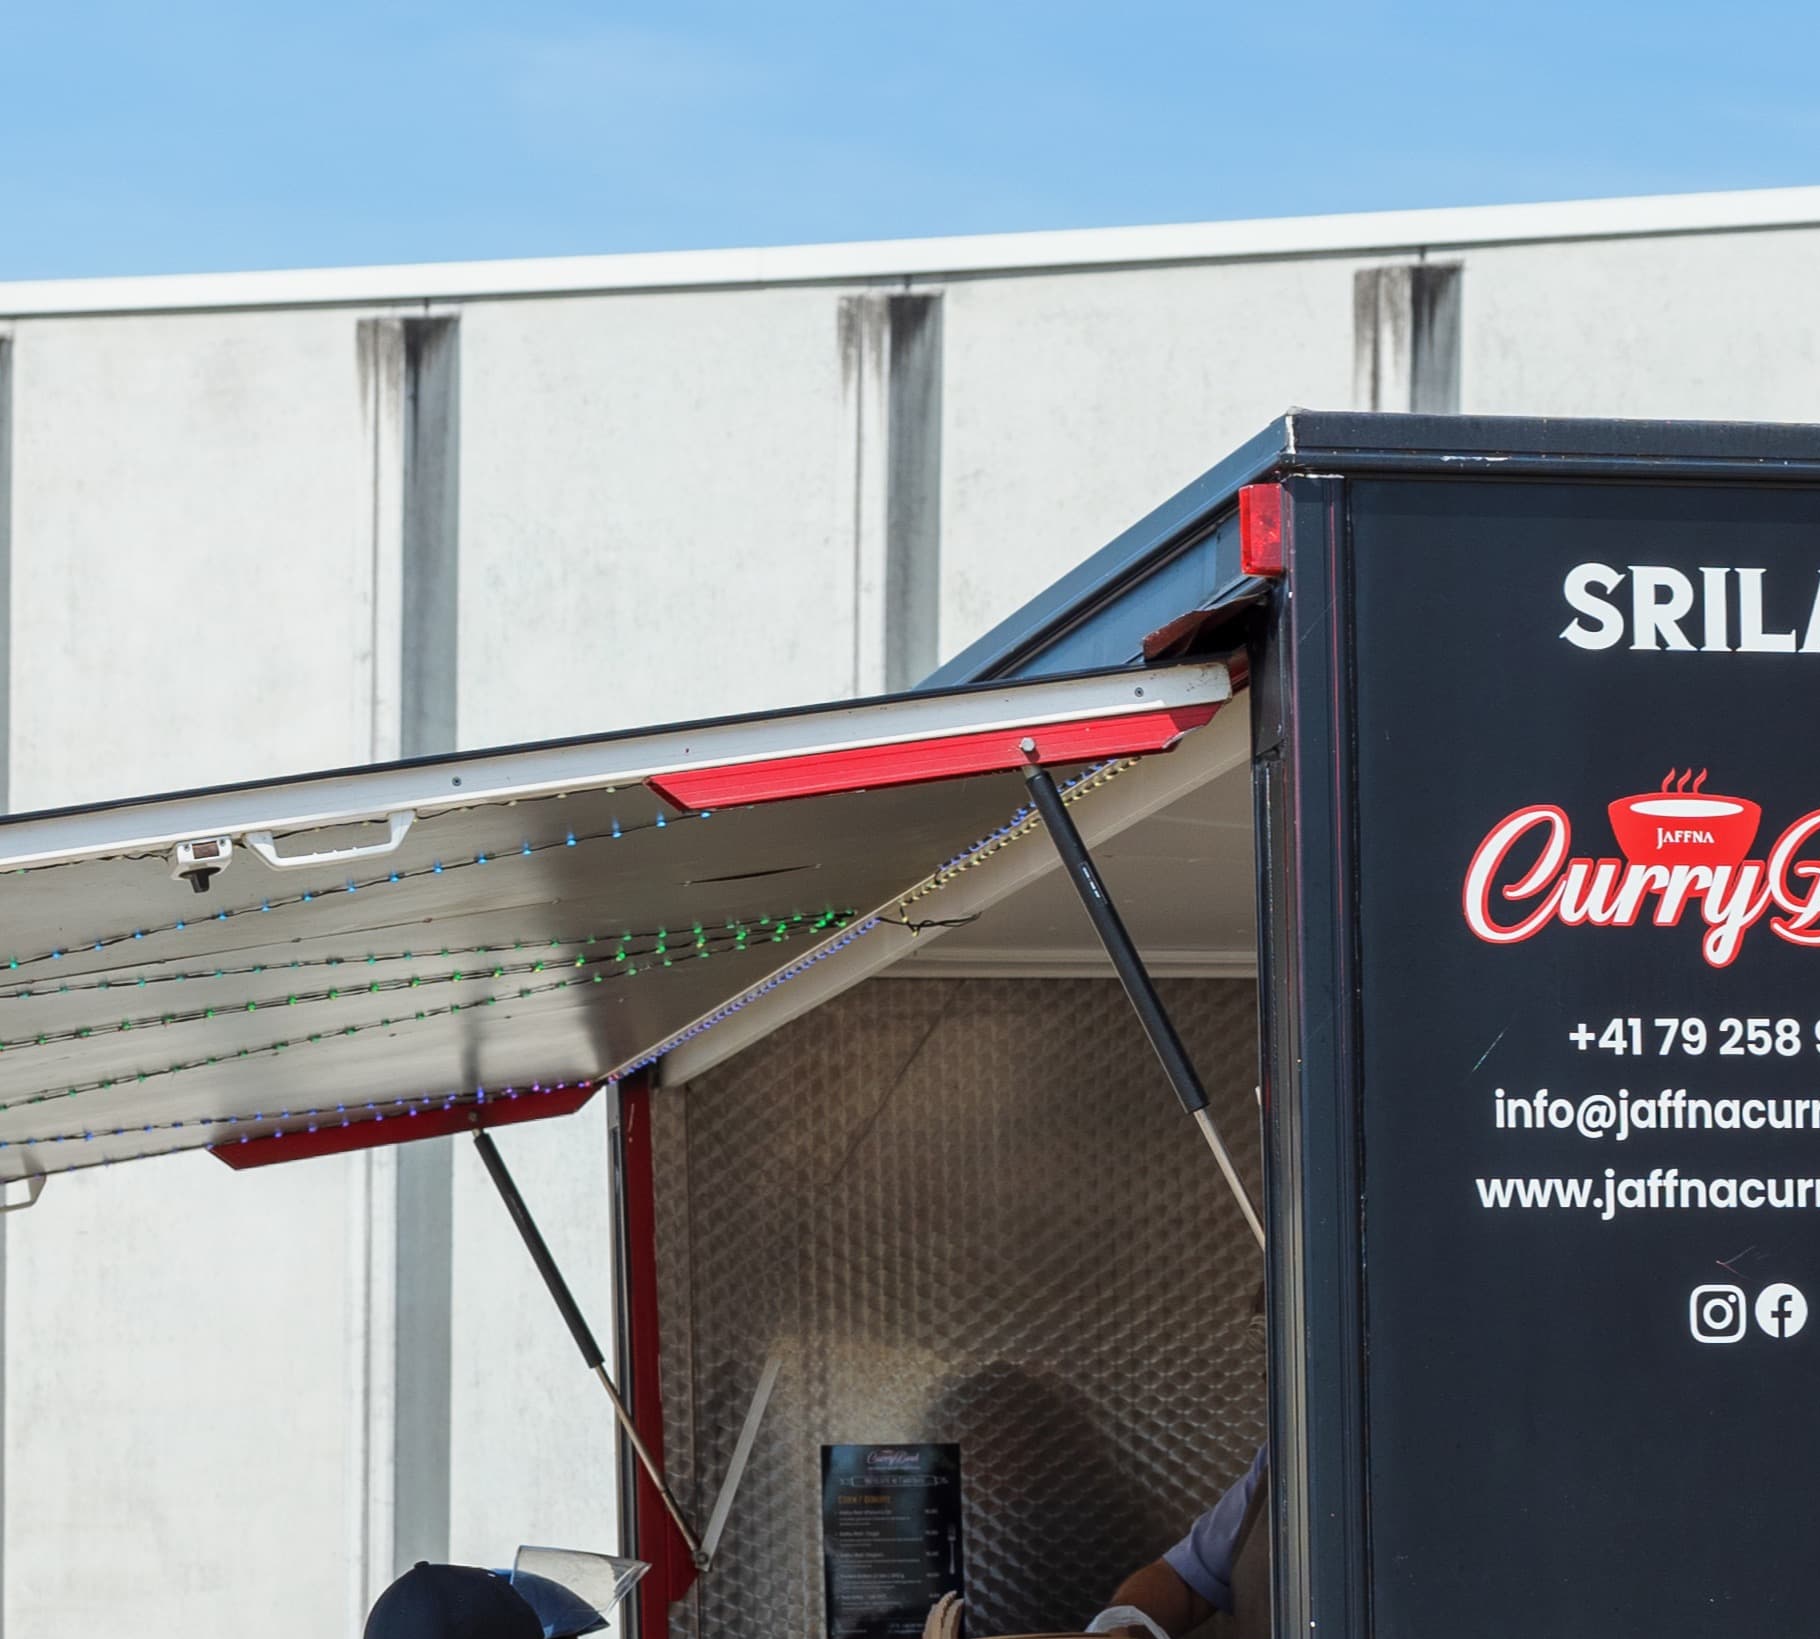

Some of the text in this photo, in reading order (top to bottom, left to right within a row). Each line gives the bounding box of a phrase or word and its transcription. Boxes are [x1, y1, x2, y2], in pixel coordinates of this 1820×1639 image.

[1656, 827, 1715, 850] JAFFNA
[1568, 1018, 1642, 1056] +41
[1655, 1018, 1708, 1056] 79
[1719, 1018, 1802, 1056] 258
